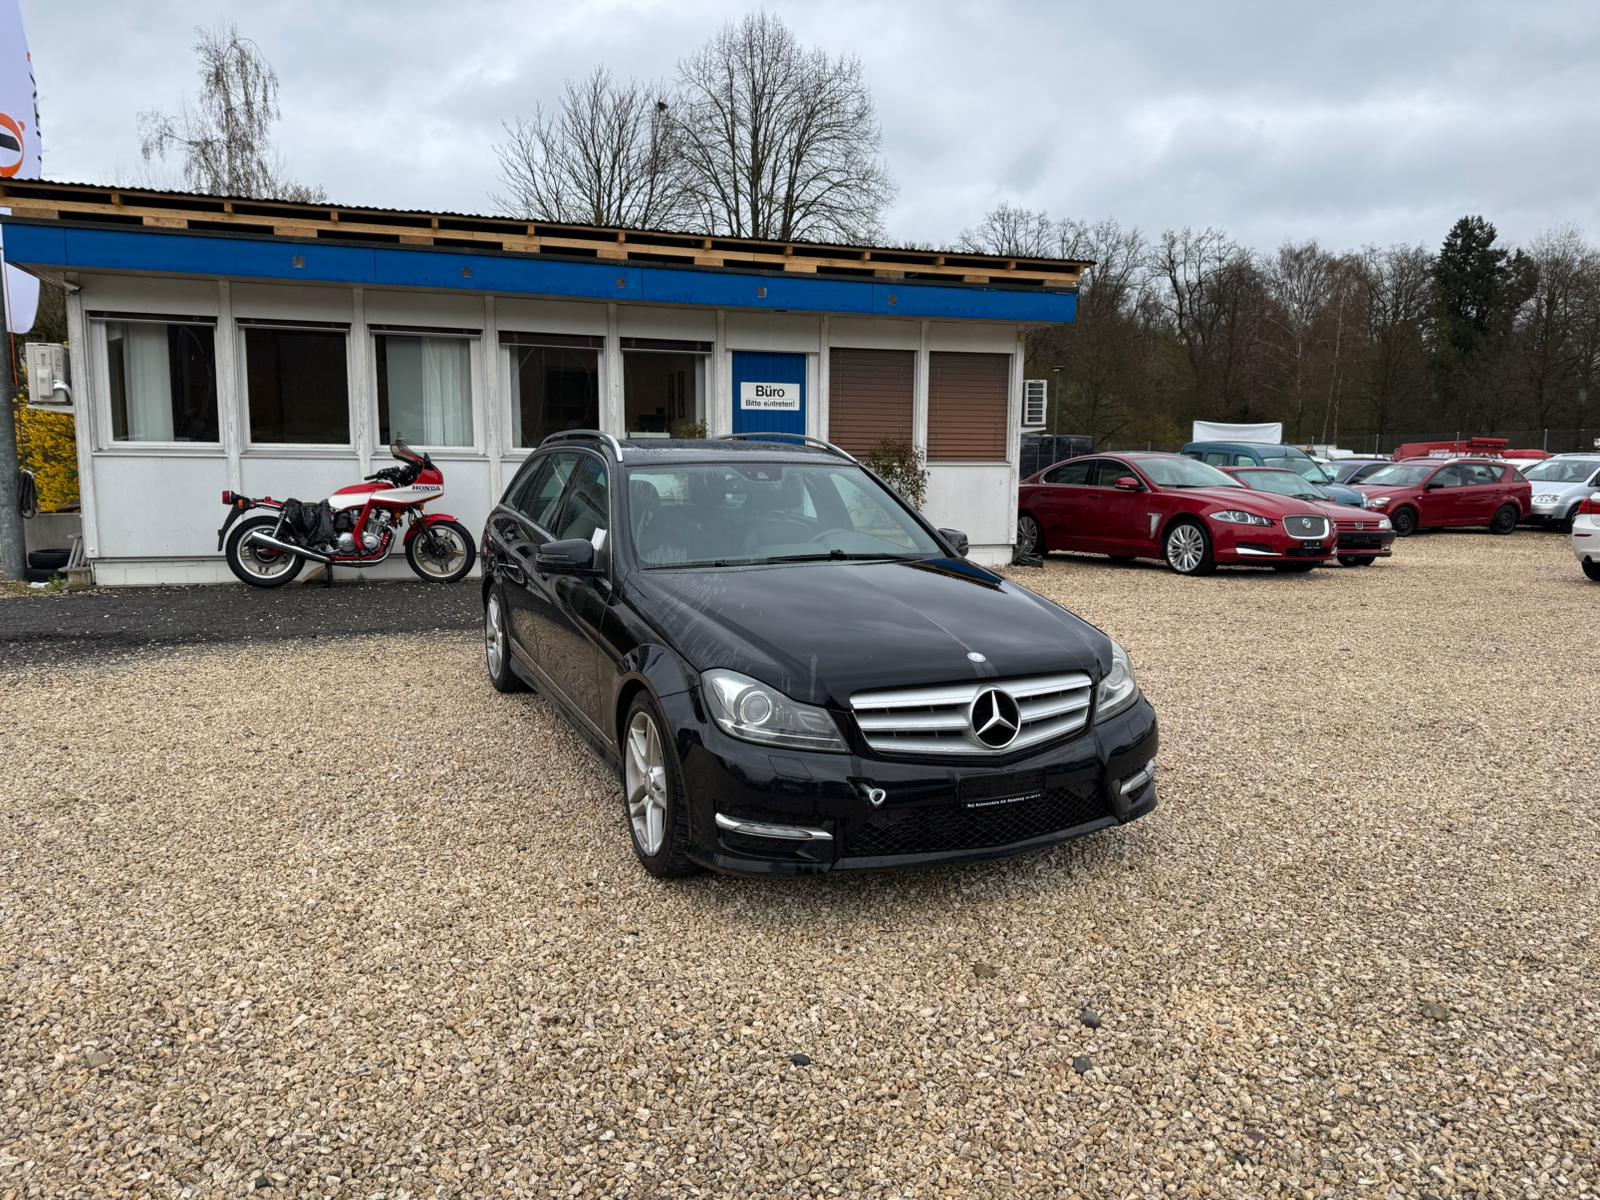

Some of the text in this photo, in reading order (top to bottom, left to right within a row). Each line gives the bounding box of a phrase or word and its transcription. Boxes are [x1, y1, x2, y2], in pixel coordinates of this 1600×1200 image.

[755, 385, 785, 398] Büro
[745, 399, 796, 408] Bitte eintreten!
